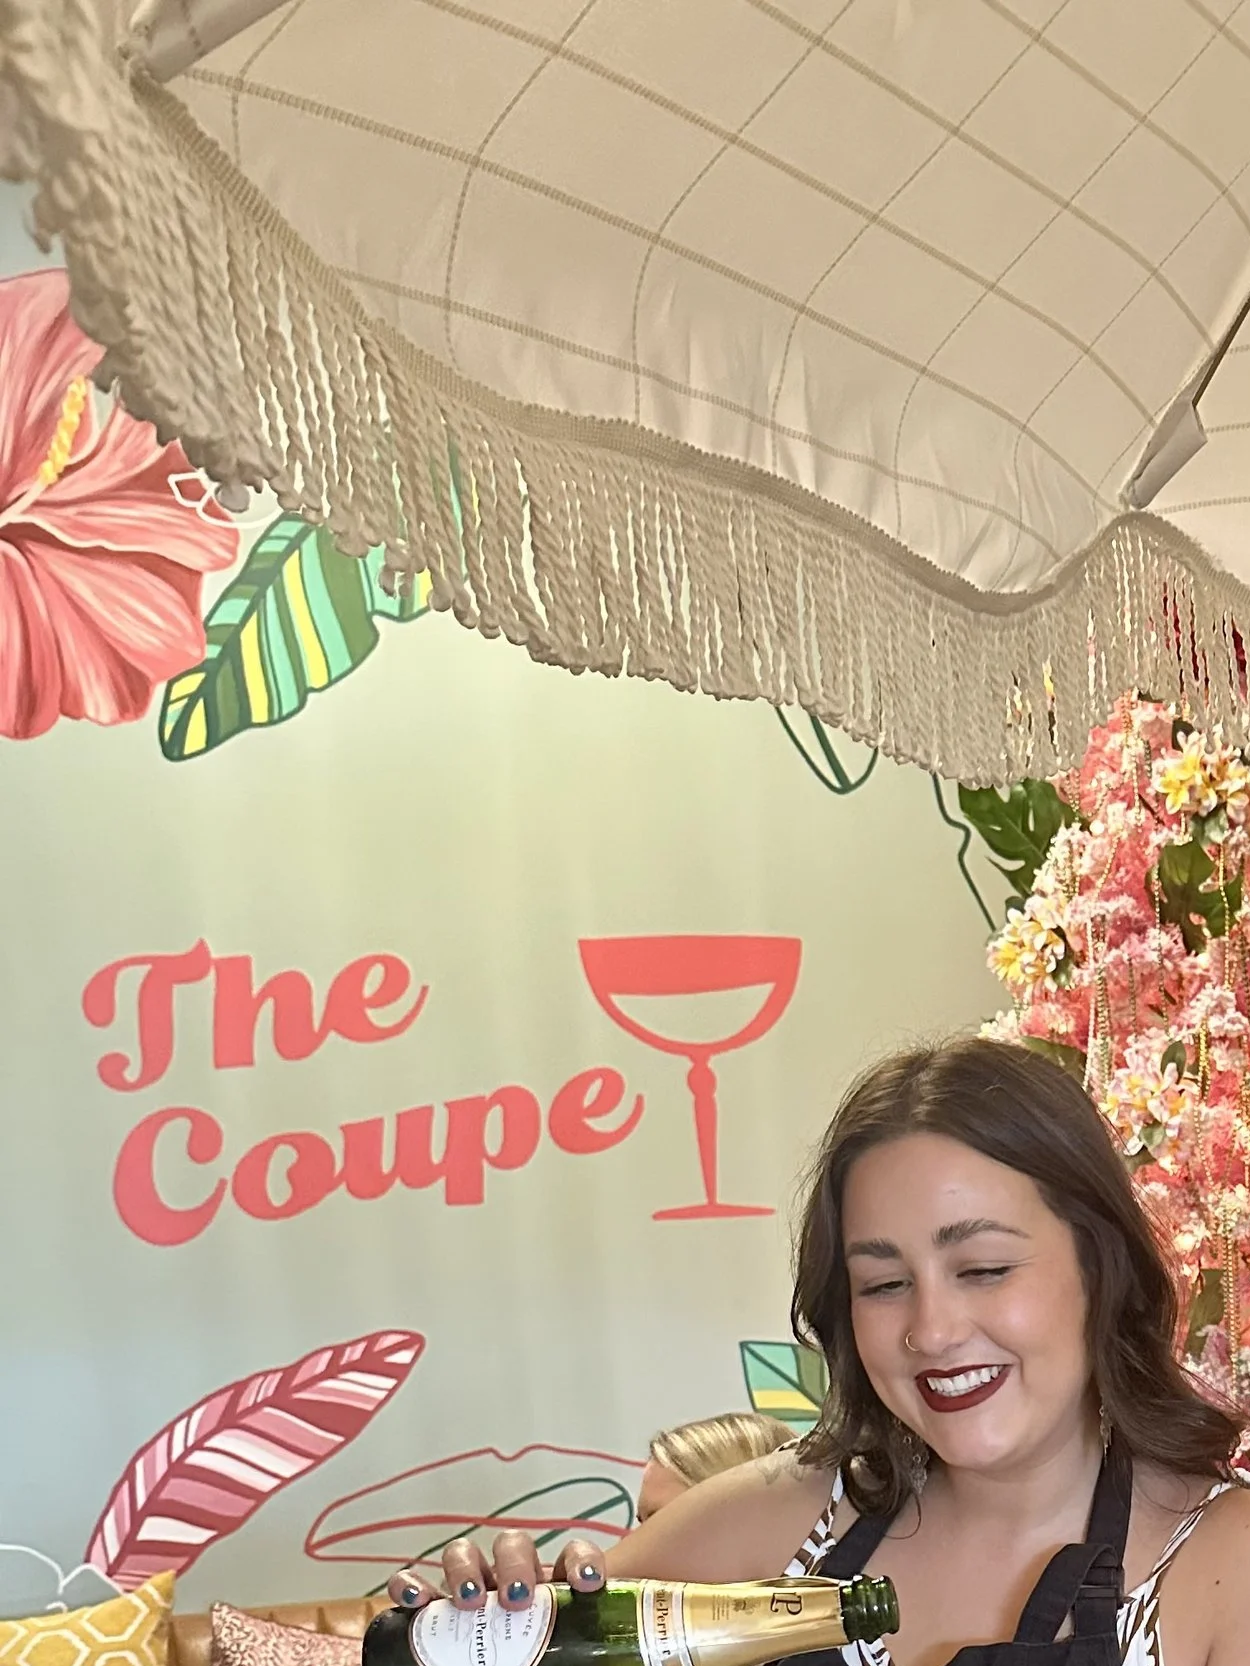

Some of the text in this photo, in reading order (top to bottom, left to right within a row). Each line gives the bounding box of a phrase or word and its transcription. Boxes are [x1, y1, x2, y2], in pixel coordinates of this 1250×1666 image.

[82, 937, 429, 1093] The
[113, 1066, 644, 1247] Coupe
[475, 1606, 487, 1666] nt-Perrier
